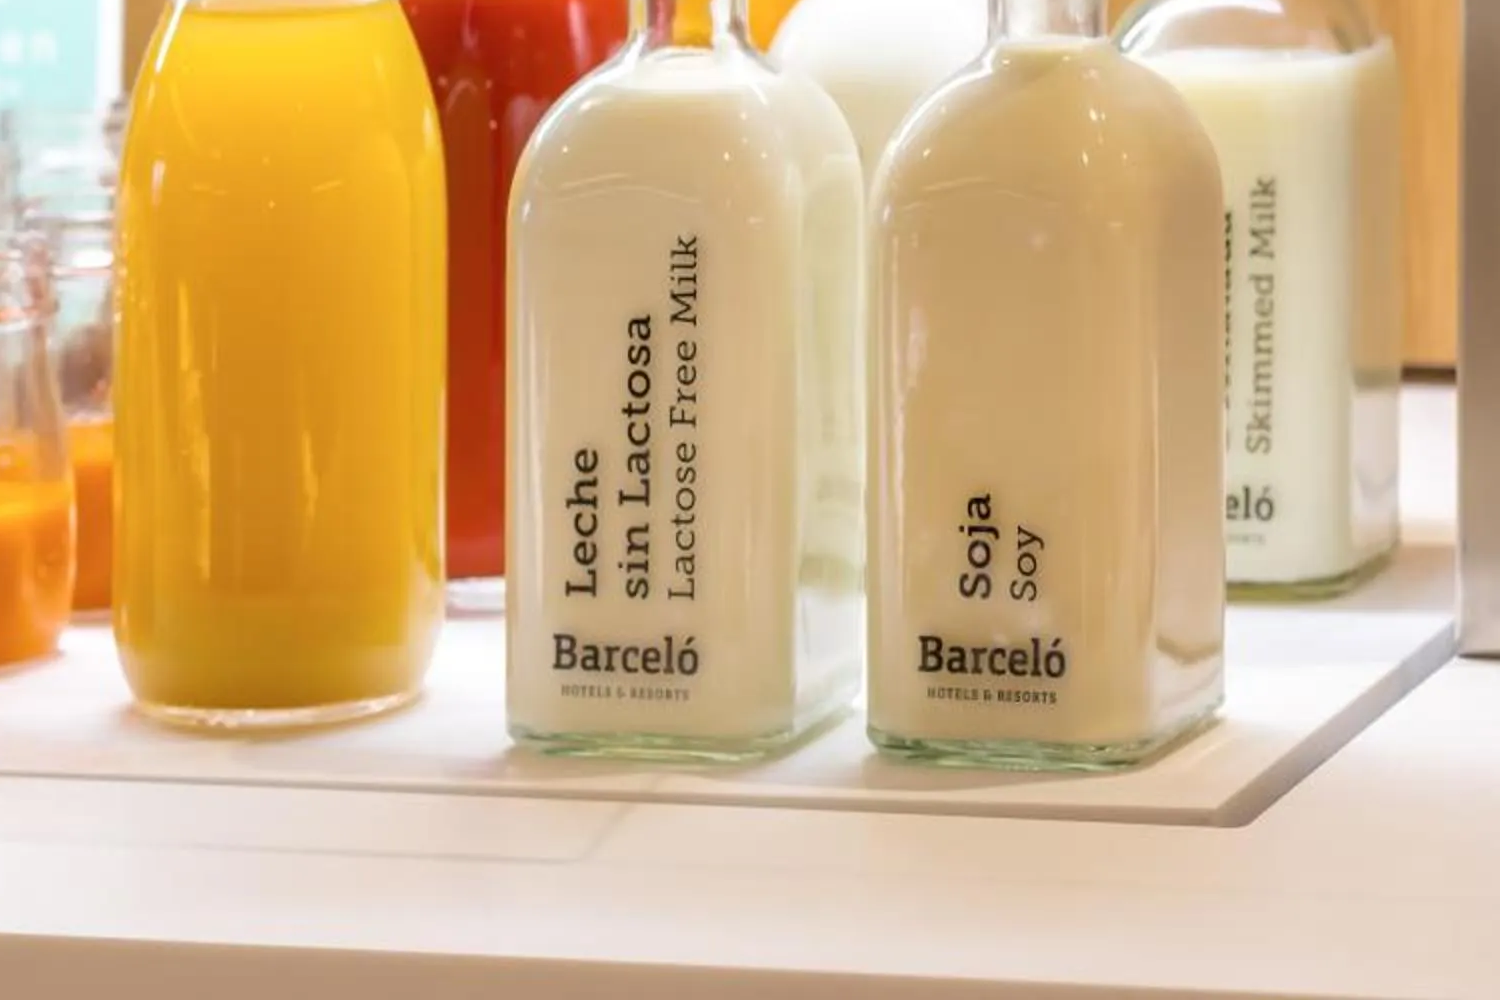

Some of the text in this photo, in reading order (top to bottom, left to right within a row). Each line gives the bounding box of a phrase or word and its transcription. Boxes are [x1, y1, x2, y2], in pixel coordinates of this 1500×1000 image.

[1248, 177, 1276, 260] Milk
[1245, 273, 1275, 454] Skimmed
[617, 313, 652, 600] sin Lactosa
[667, 236, 698, 601] Lactose Free Milk
[565, 448, 599, 598] Leche
[958, 493, 1001, 599] Soja
[1009, 524, 1045, 602] Soy
[552, 633, 699, 676] Barceló
[561, 684, 612, 699] HOTELS
[629, 686, 690, 701] RESORTS
[918, 635, 1067, 679] Barceló
[927, 686, 980, 701] HOTELS
[997, 689, 1057, 704] RESORTS
